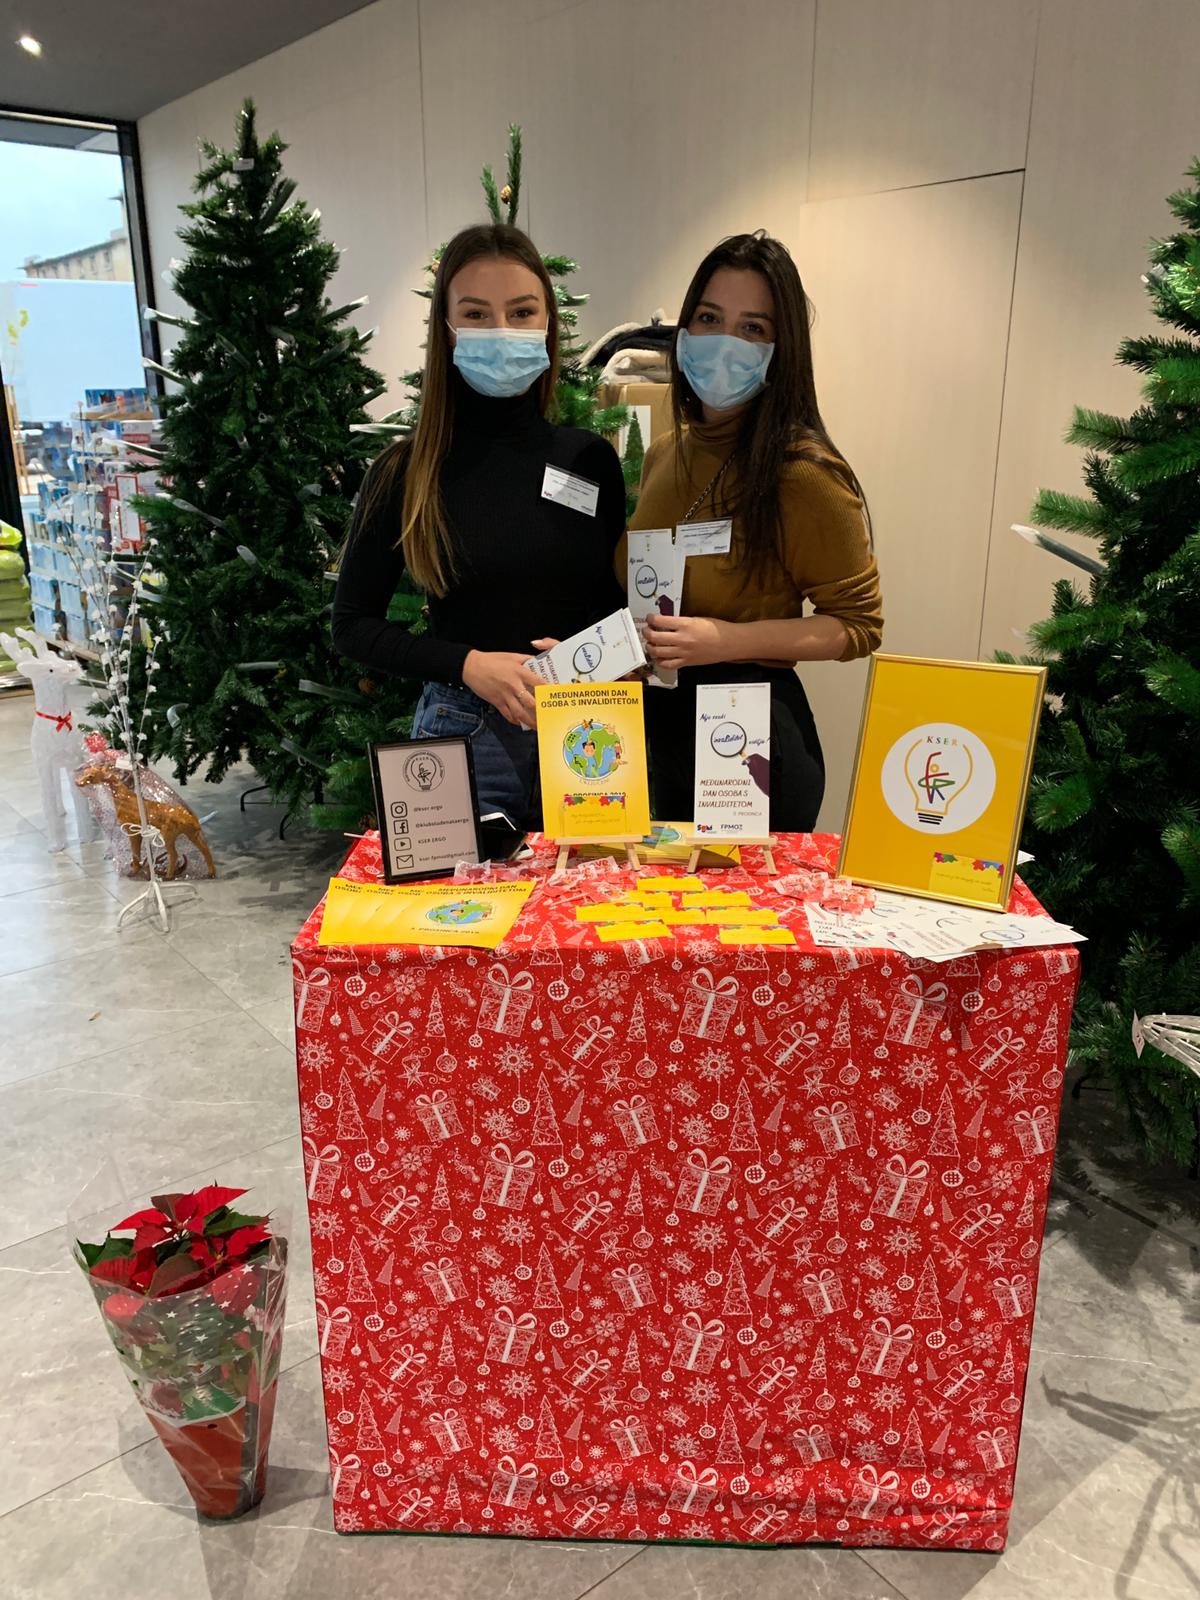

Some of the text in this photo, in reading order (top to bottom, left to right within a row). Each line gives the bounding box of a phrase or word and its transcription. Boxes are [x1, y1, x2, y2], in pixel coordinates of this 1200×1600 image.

[549, 689, 628, 699] MEĐUNARODNI DAN
[541, 698, 639, 708] OSOBA S INVALIDITETOM
[702, 789, 749, 797] DAN OSOBA S
[698, 800, 753, 808] INVALIDITETOM
